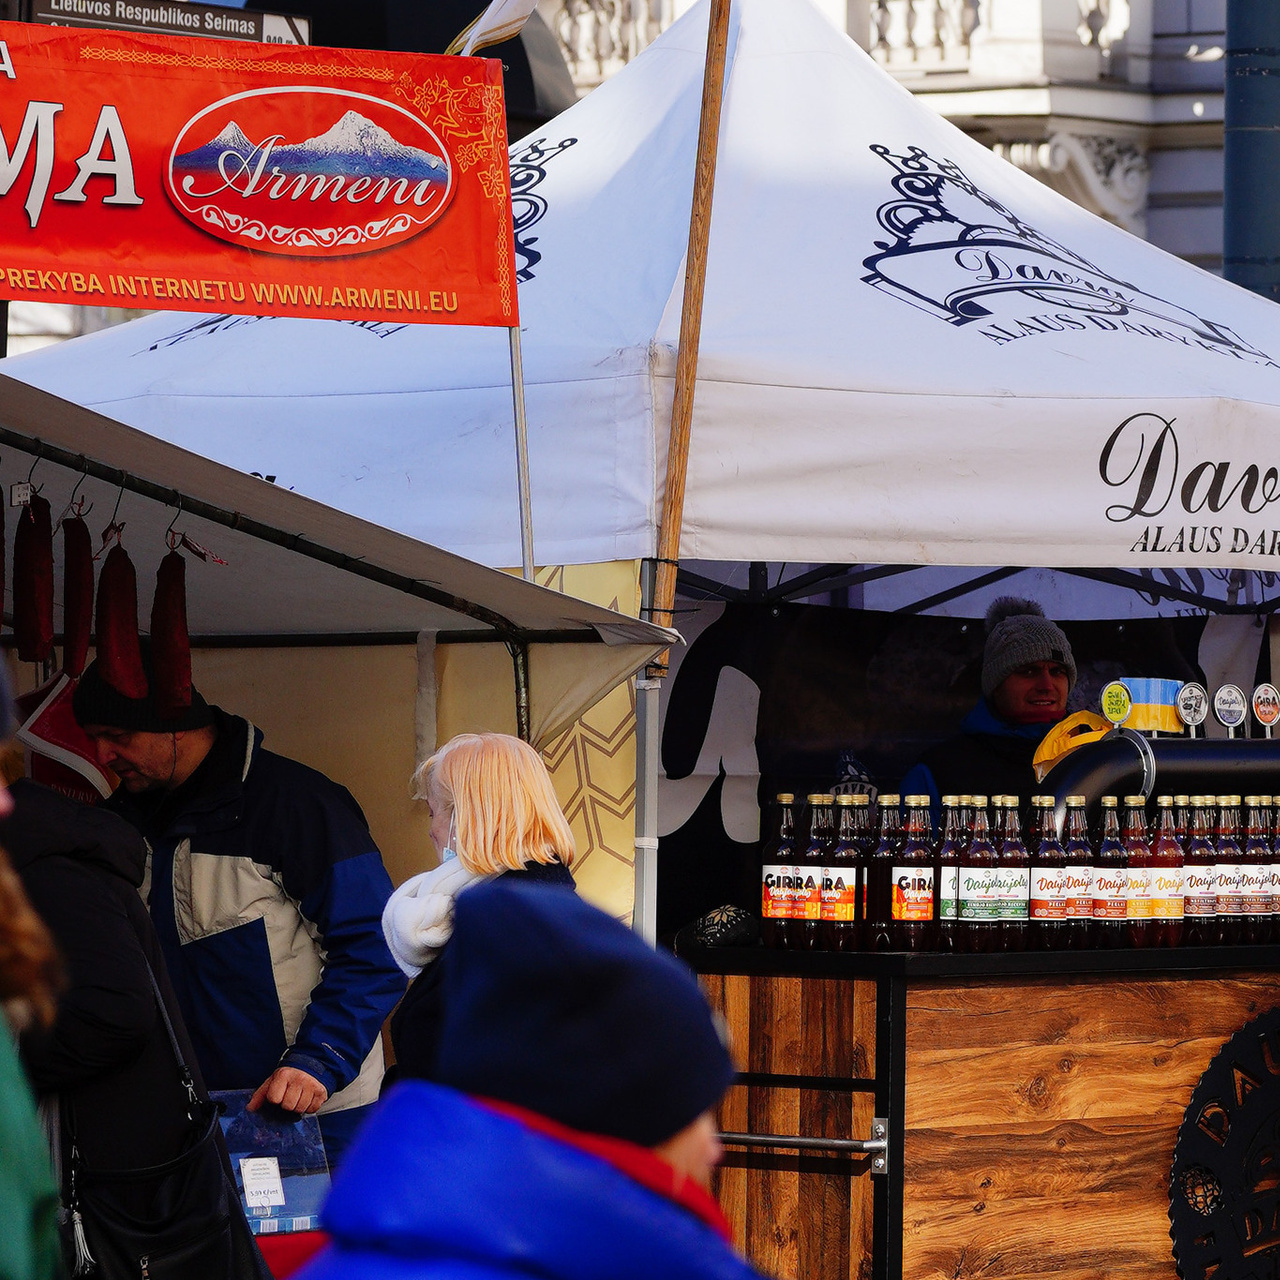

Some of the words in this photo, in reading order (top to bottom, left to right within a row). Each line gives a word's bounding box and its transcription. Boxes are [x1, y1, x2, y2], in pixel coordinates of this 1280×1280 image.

[115, 0, 200, 28] Respublikos
[205, 12, 256, 35] Seimas
[182, 135, 440, 206] Armeni
[110, 275, 245, 302] INTERNETU
[250, 282, 458, 312] WWW.ARMENI.EU
[954, 247, 1137, 304] Davra
[978, 312, 1087, 347] ALAUS
[1130, 525, 1223, 554] ALAUS
